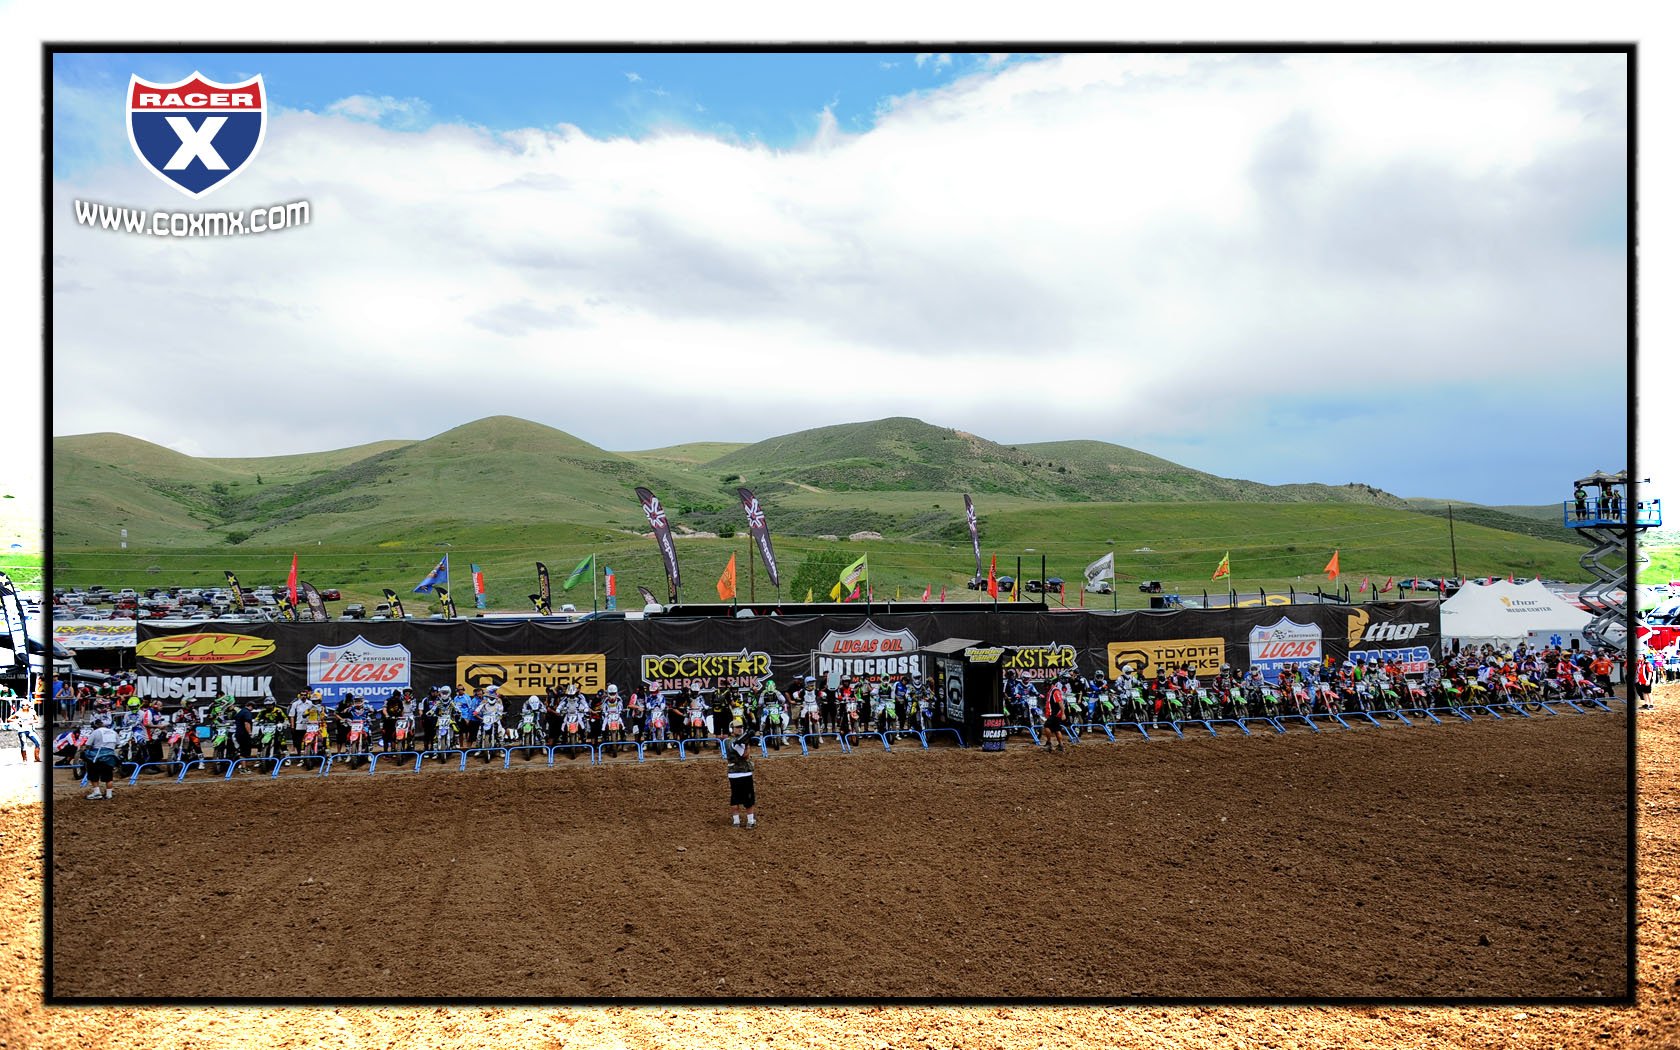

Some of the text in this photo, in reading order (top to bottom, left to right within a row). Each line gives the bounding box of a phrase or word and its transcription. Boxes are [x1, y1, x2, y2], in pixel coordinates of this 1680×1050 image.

[1366, 622, 1429, 641] thor
[136, 636, 275, 656] FMF
[833, 638, 903, 653] LUCAS OIL
[1154, 647, 1219, 658] TOYOTA
[1258, 641, 1317, 658] LUCAS
[320, 663, 404, 682] LUCAS
[514, 662, 598, 674] TOYOTA
[819, 655, 919, 677] MOTOCROSS
[137, 675, 272, 698] MUSCLE MILK
[514, 676, 598, 688] TRUCKS
[313, 687, 335, 696] OIL
[983, 730, 1000, 738] LUCAS
